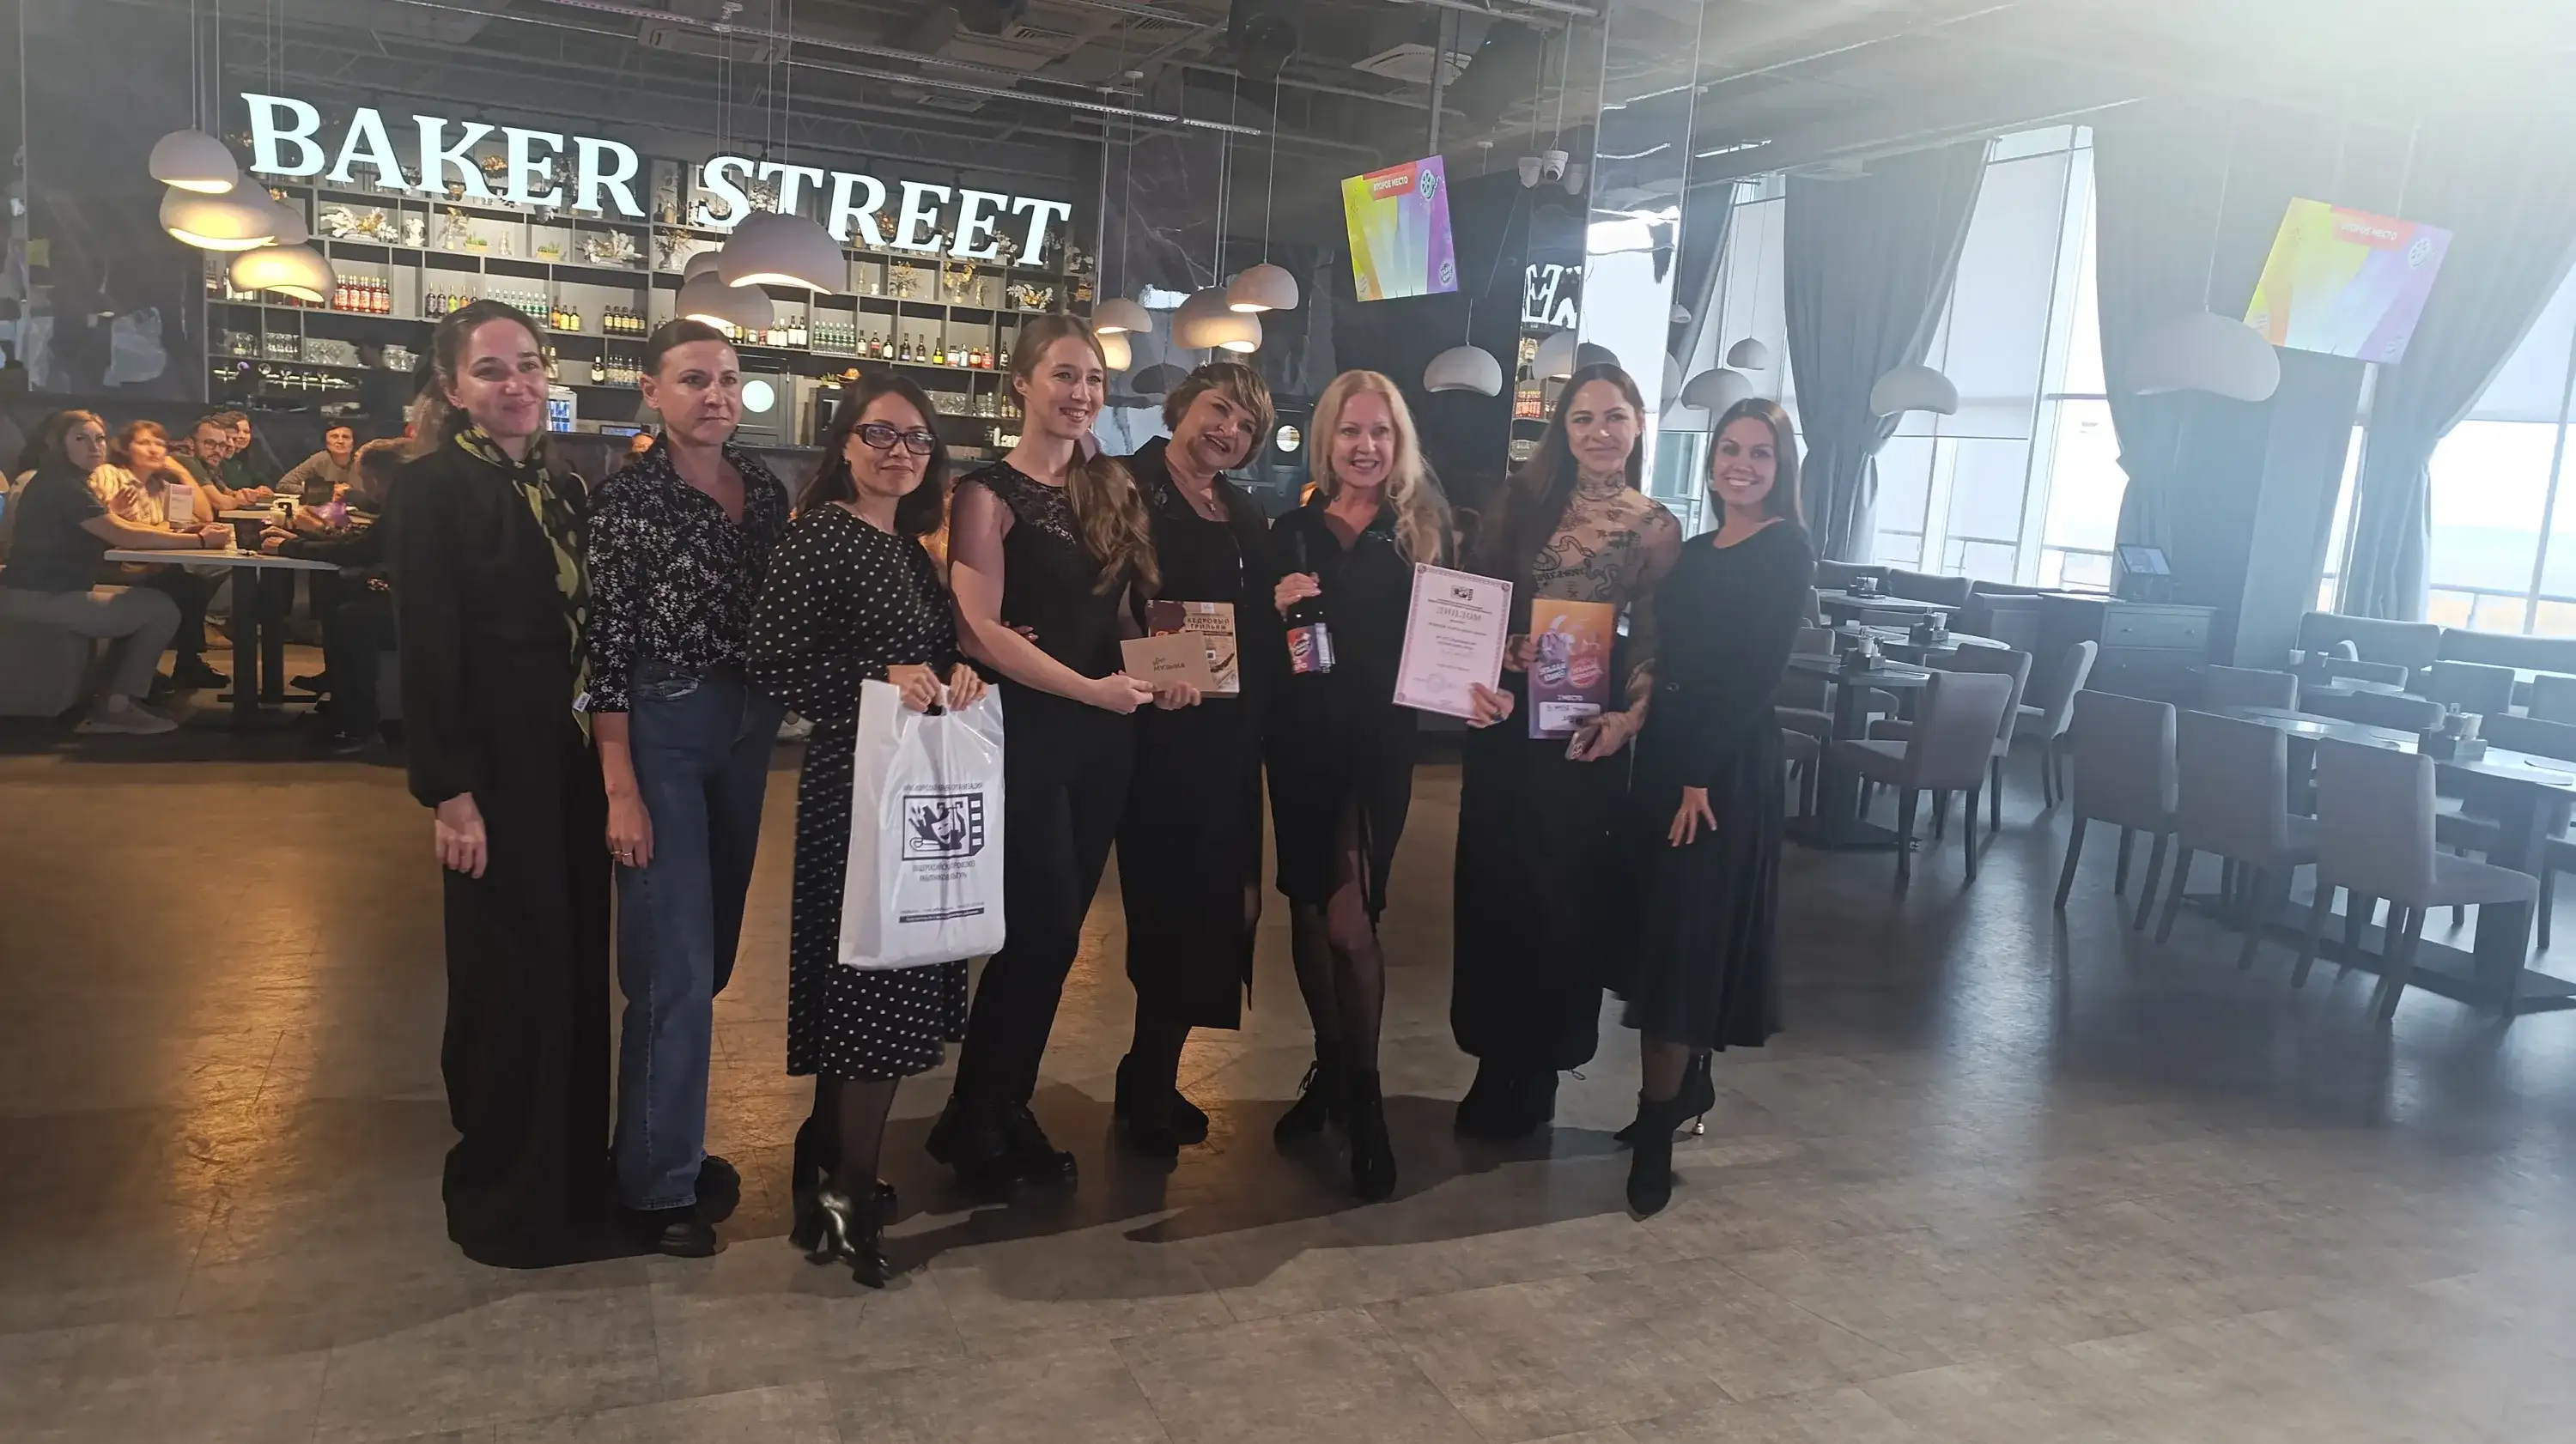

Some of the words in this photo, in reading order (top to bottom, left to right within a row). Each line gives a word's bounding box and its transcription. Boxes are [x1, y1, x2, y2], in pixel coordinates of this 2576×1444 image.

[240, 93, 646, 218] BAKER
[697, 155, 1072, 266] STREET
[1392, 176, 1408, 187] МЕСТО
